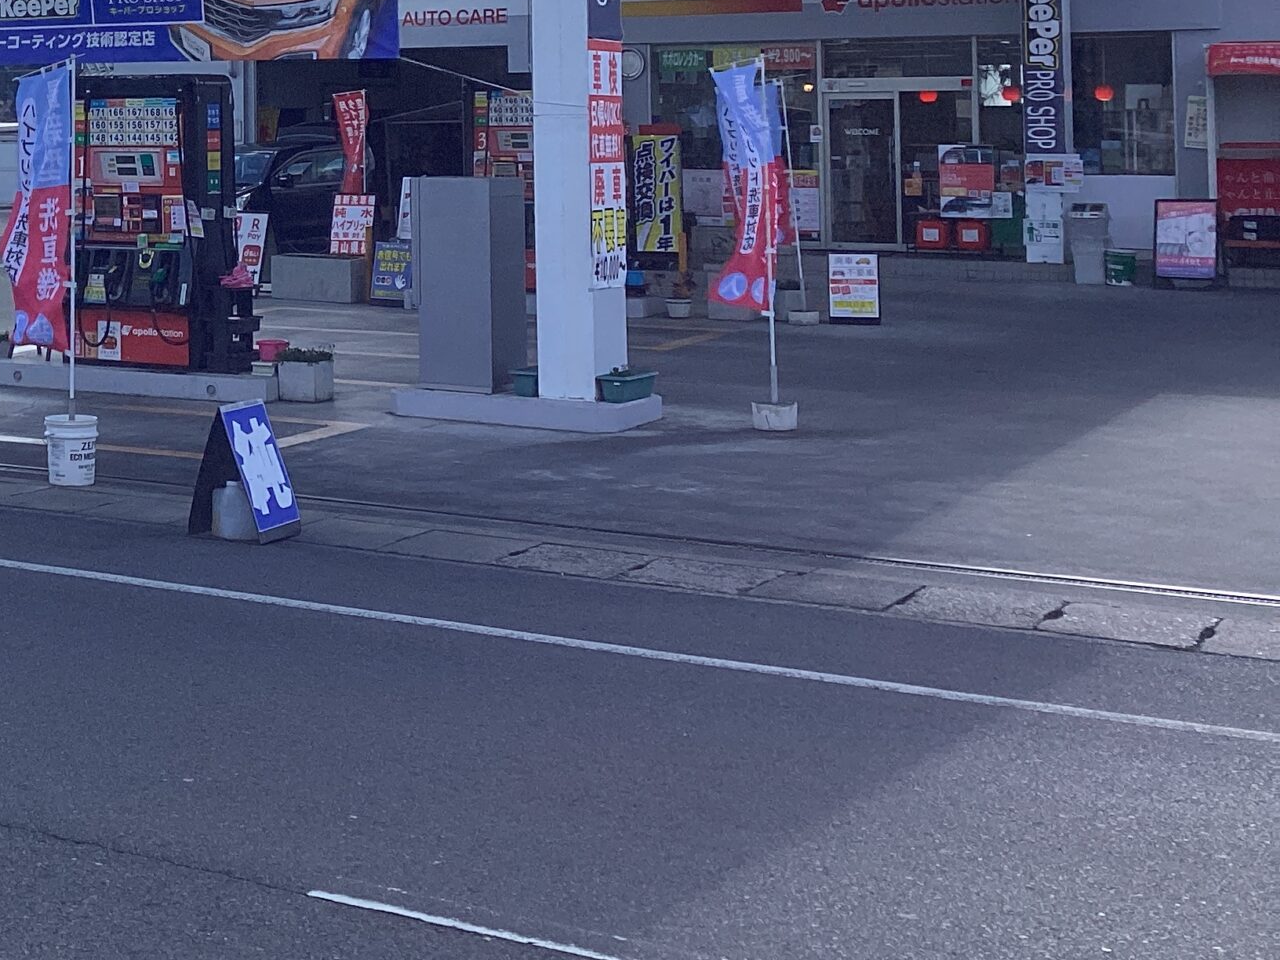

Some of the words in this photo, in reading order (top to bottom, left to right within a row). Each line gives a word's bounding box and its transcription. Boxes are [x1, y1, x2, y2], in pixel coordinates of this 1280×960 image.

[402, 10, 451, 26] AUTO
[456, 8, 508, 25] CARE
[591, 50, 619, 94] 車検
[1027, 70, 1054, 101] PRO
[109, 108, 123, 116] 166
[127, 108, 141, 116] 167
[164, 107, 177, 115] 16
[91, 121, 106, 130] 160
[109, 121, 123, 129] 155
[127, 121, 142, 129] 156
[145, 120, 160, 129] 157
[1027, 106, 1056, 149] SHOP
[91, 134, 106, 142] 148
[109, 134, 124, 142] 143
[145, 133, 160, 141] 145
[478, 132, 486, 149] 3
[634, 142, 657, 224] 点検交換
[252, 219, 259, 229] R
[132, 325, 184, 339] apollotation
[232, 417, 291, 514] 純
